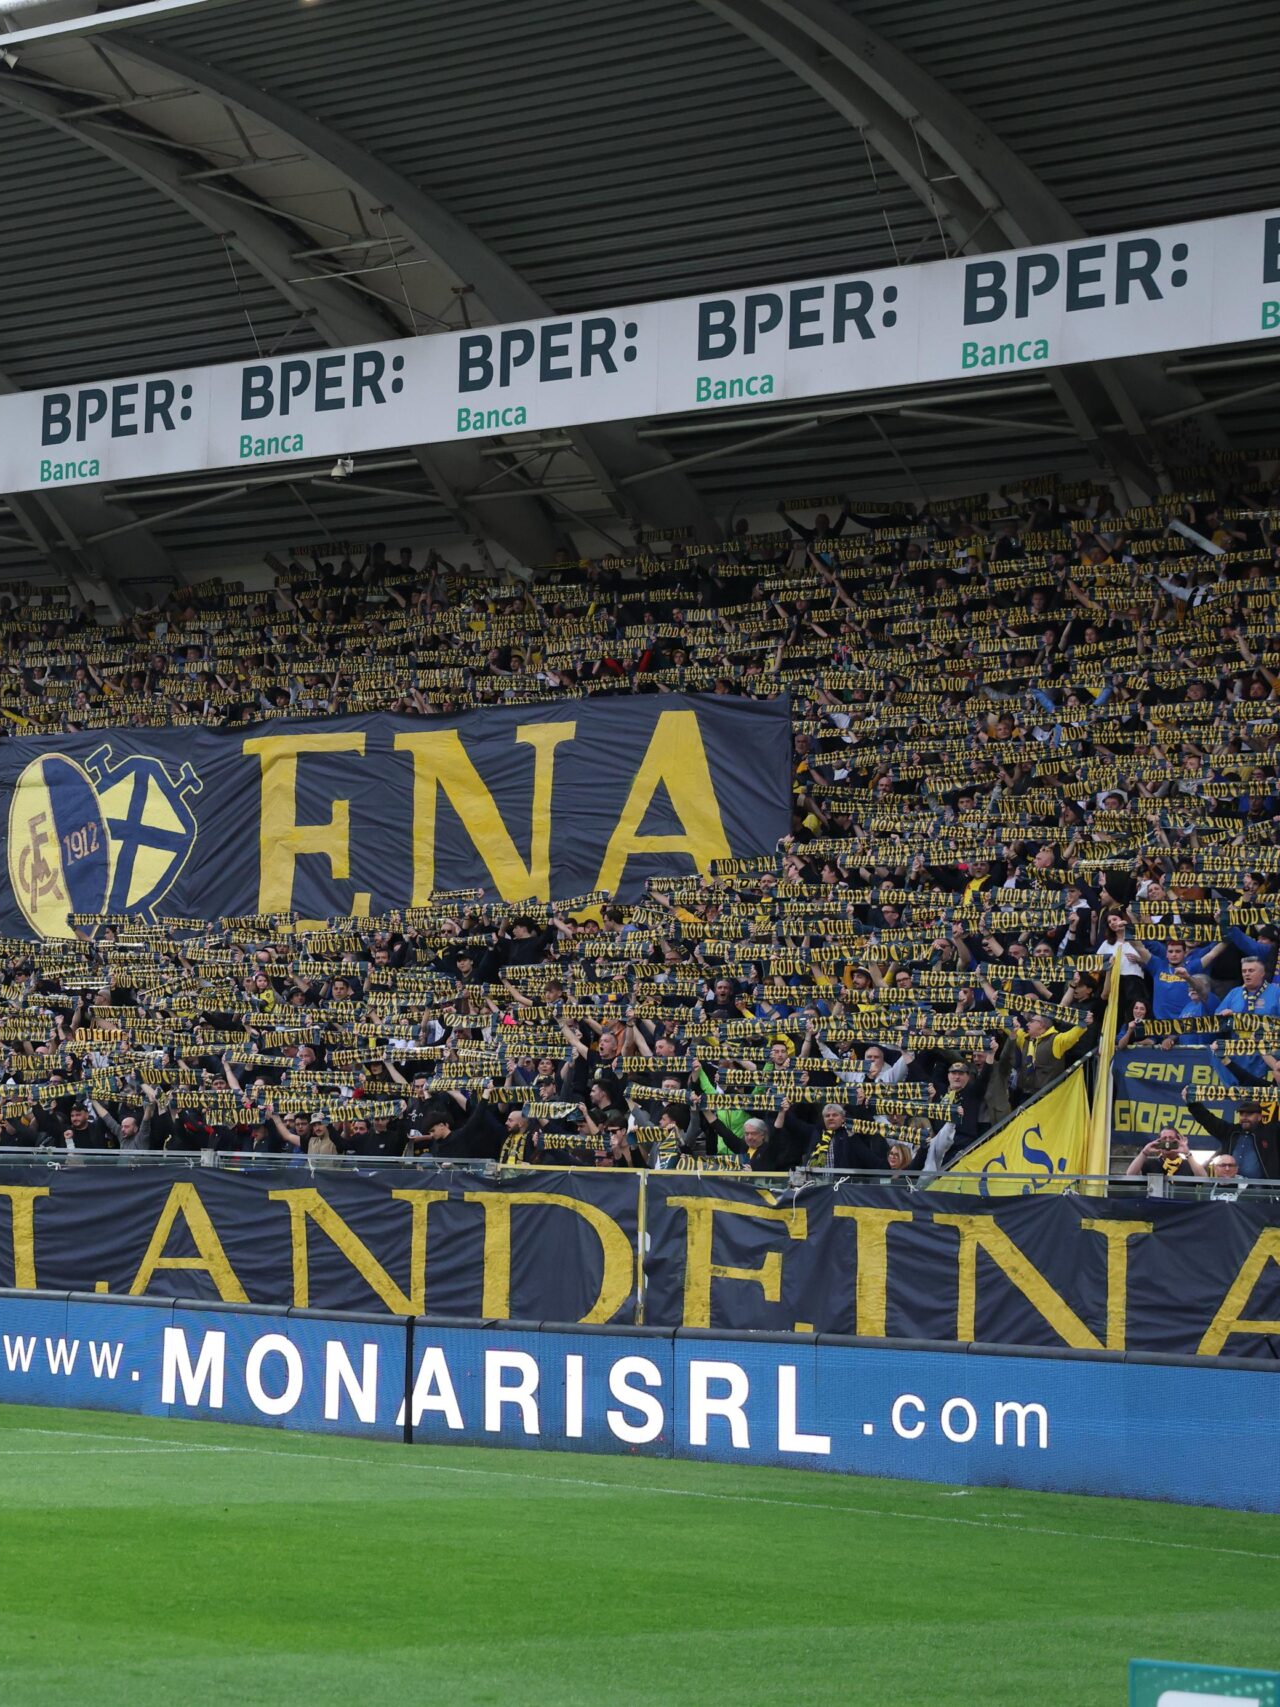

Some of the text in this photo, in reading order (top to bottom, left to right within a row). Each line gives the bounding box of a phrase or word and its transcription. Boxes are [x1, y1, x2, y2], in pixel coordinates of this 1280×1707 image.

[964, 238, 1188, 325] BPER:
[698, 281, 897, 361] BPER:
[459, 318, 637, 392] BPER:
[961, 339, 1049, 368] Banca
[241, 351, 404, 420] BPER:
[696, 374, 774, 402] Banca
[42, 380, 192, 446] BPER:
[457, 406, 526, 432] Banca
[240, 434, 304, 458] Banca
[40, 459, 99, 482] Banca
[1149, 702, 1214, 719] MOD ENA
[948, 722, 968, 734] ENA
[1209, 752, 1278, 767] MOD ENA
[1203, 781, 1272, 798] MOD ENA
[63, 822, 100, 866] 1912
[1204, 856, 1278, 873] MOD ENA
[1170, 872, 1238, 888] MOD ENA
[838, 890, 862, 903] MOD
[879, 890, 953, 906] MOD ENA
[1140, 899, 1220, 915] MOD ENA
[991, 909, 1066, 928] MOD ENA
[1229, 908, 1258, 925] MOD
[1134, 924, 1222, 941] MOD ENA
[811, 945, 841, 962] MOD
[920, 971, 946, 986] MOD
[988, 964, 1065, 982] MOD ENA
[812, 986, 834, 998] ENA
[879, 988, 953, 1002] MOD ENA
[853, 1013, 878, 1029] MOD
[932, 1014, 1005, 1030] MOD ENA
[1144, 1015, 1220, 1036] MOD ENA
[1232, 1013, 1260, 1031] MOD
[908, 1035, 984, 1051] MOD ENA
[1224, 1040, 1256, 1056] MOD
[696, 1045, 765, 1061] MOD ENA
[11, 1055, 62, 1070] MOD ENA
[442, 1062, 502, 1078] MOD ENA
[622, 1056, 687, 1072] MOD ENA
[140, 1069, 197, 1085] MOD ENA
[291, 1071, 355, 1086] MOD ENA
[725, 1069, 751, 1084] MOD
[1125, 1062, 1184, 1083] SAN
[39, 1085, 65, 1100] MOD
[826, 1087, 849, 1104] ENA
[898, 1082, 921, 1099] ENA
[1195, 1085, 1279, 1102] MOD ENA
[177, 1093, 237, 1109] MOD ENA
[706, 1094, 775, 1111] MOD ENA
[329, 1100, 395, 1122] MOD ENA
[636, 1127, 661, 1143] MOD
[718, 1154, 741, 1171] ENA
[162, 1328, 830, 1454] MONARISRL
